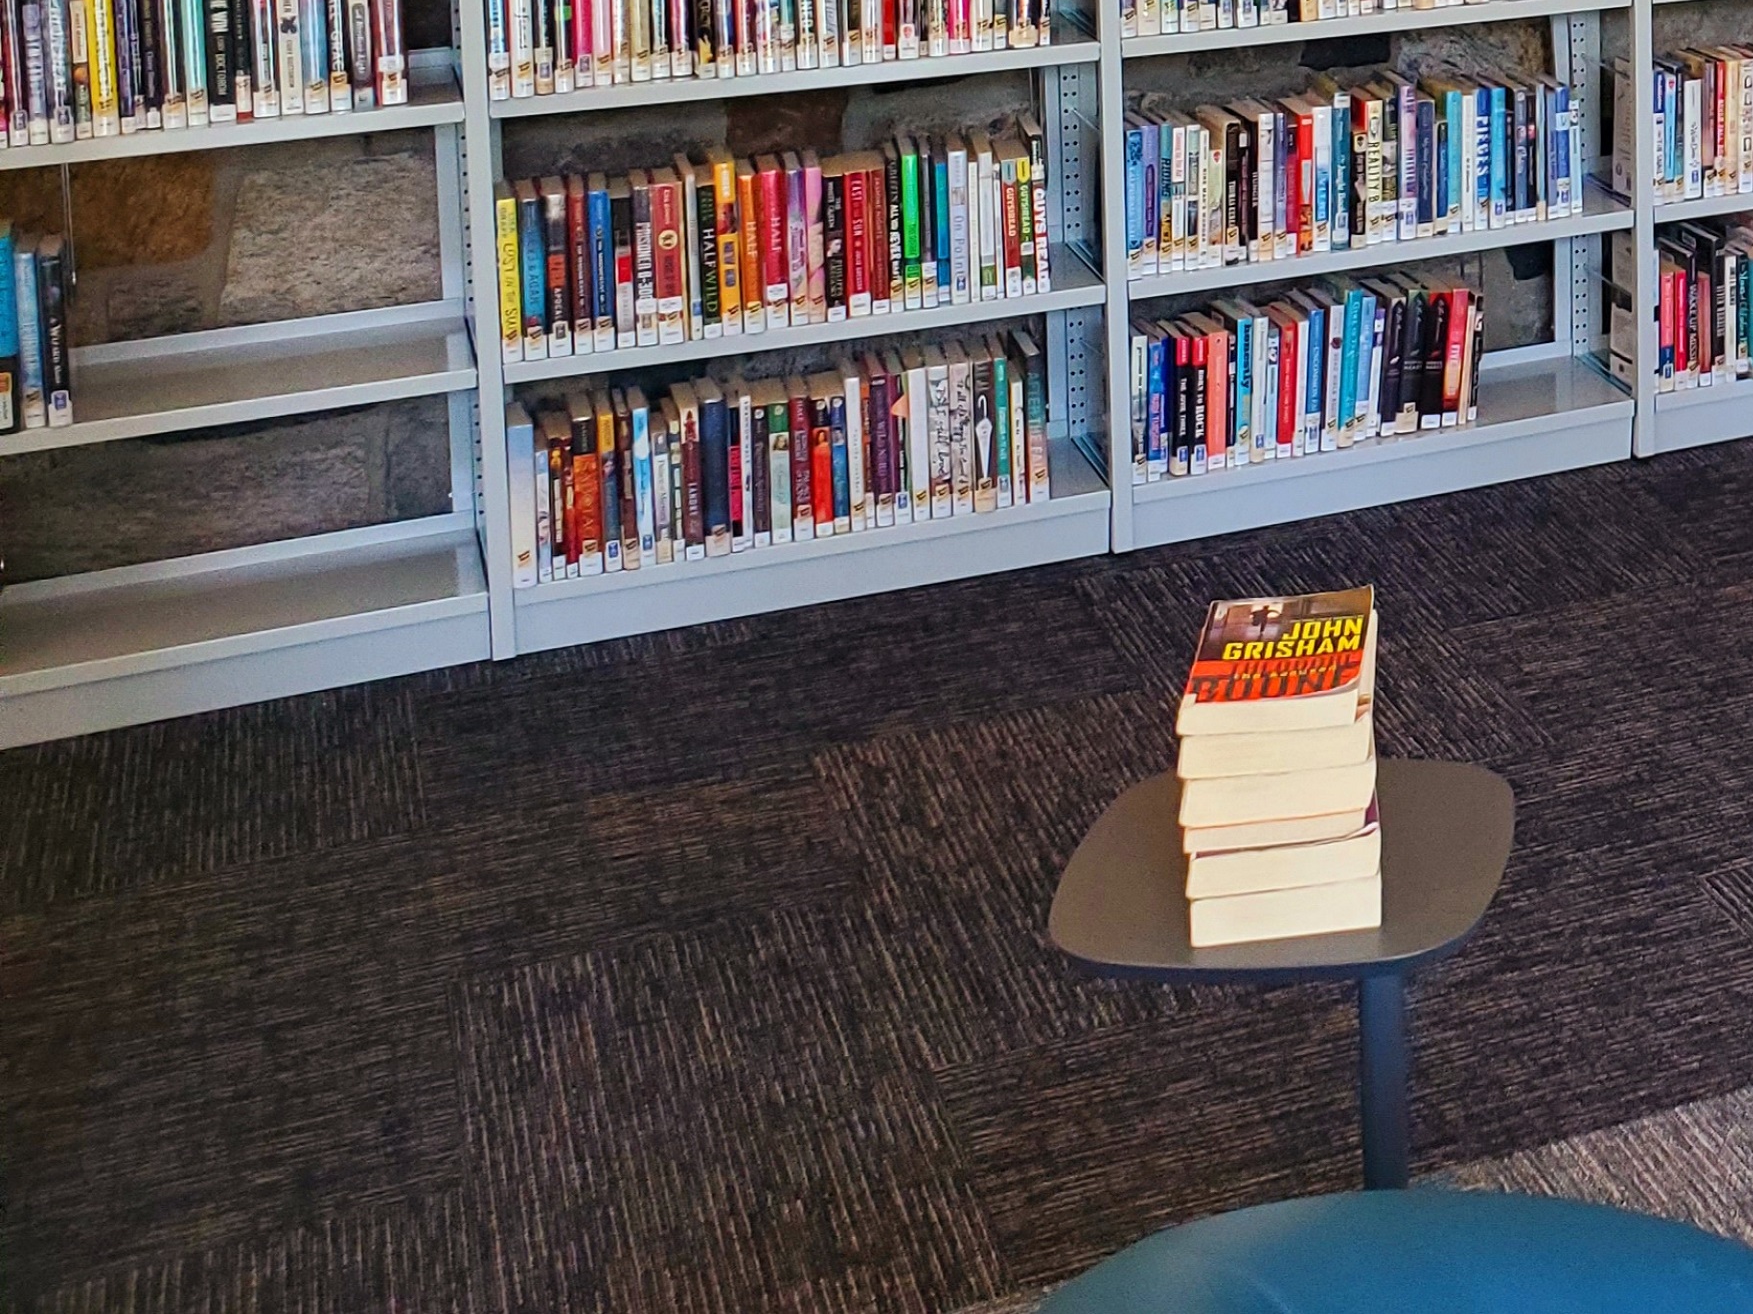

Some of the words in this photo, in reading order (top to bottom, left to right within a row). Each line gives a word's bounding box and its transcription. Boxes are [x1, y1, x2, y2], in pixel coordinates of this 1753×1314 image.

[1367, 141, 1381, 193] REALITY
[1034, 187, 1047, 233] GUYS
[702, 227, 715, 268] HALF
[746, 220, 757, 258] HALF
[770, 216, 781, 252] HALF
[1035, 237, 1049, 282] READ
[1222, 635, 1360, 661] GRISHAM
[1281, 617, 1365, 641] JOHN
